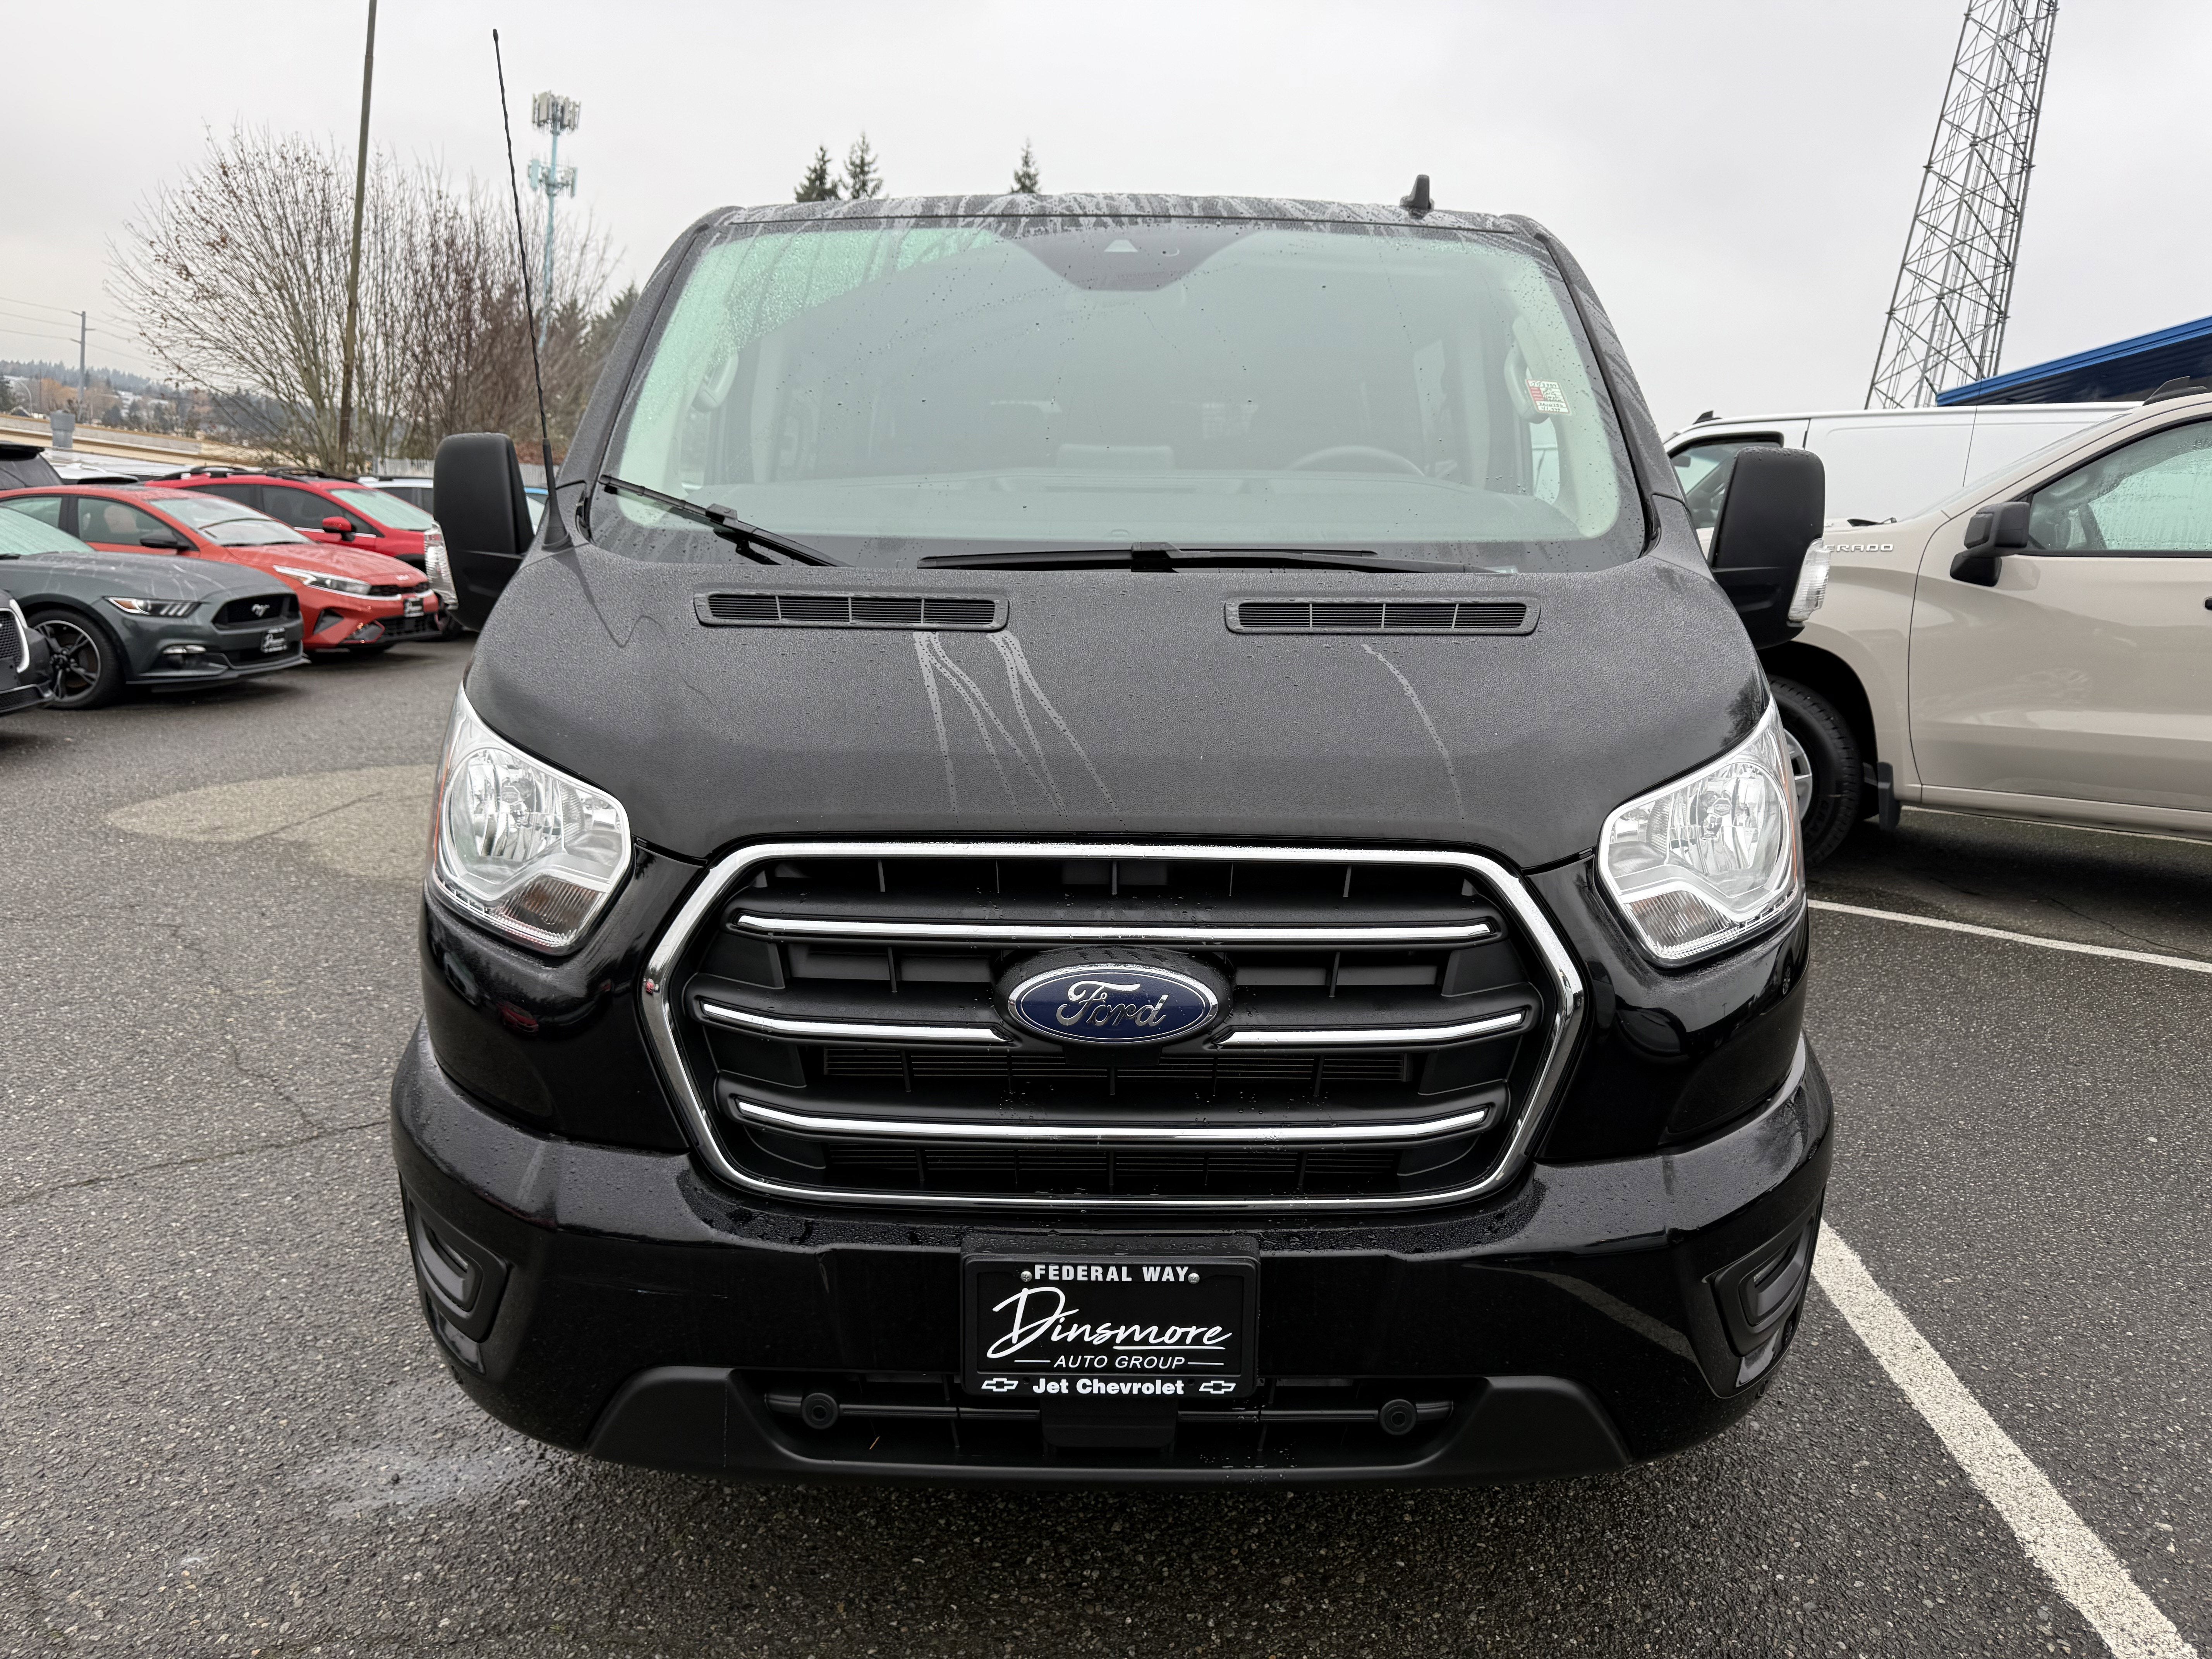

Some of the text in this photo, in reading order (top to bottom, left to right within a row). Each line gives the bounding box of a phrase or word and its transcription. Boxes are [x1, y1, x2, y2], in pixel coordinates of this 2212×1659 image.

[1056, 980, 1168, 1027] Ford
[1034, 1264, 1189, 1282] FEDERAL WAY
[986, 1286, 1233, 1359] Dinsmore
[1053, 1355, 1185, 1369] AUTO GROUP
[1032, 1378, 1184, 1395] Jet Chevrolet
